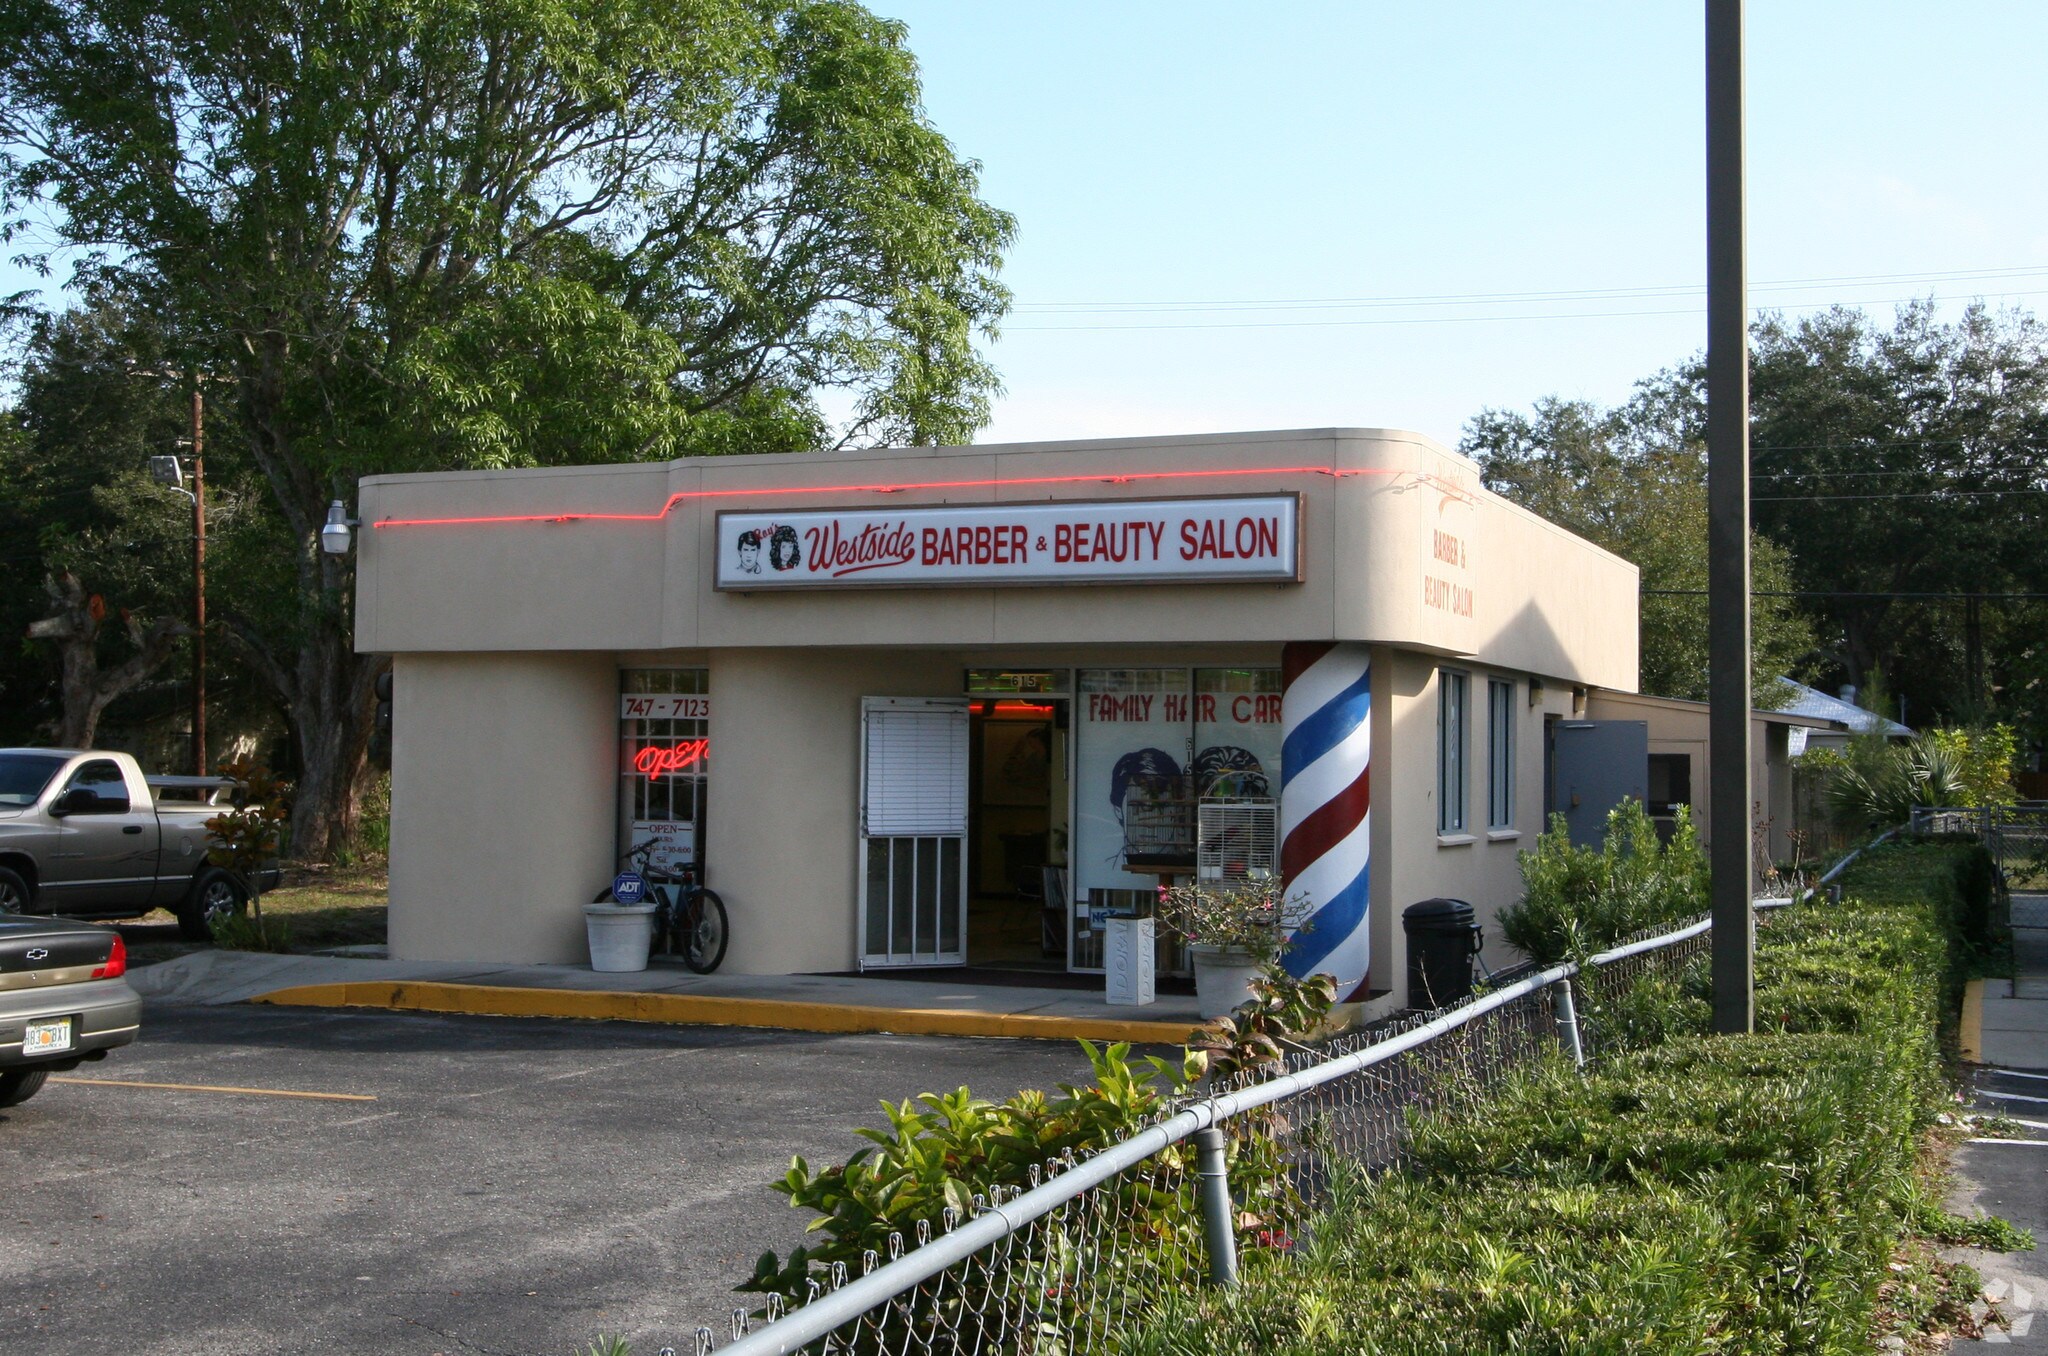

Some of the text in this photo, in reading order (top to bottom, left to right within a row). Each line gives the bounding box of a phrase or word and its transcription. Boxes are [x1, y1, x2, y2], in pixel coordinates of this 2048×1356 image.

[804, 517, 1278, 578] Westside BARBER & BEAUTY SALON
[1433, 528, 1467, 569] BARBER &
[1424, 574, 1474, 619] BEAUTY SALON
[1011, 675, 1036, 687] 615
[625, 698, 655, 717] 747
[672, 698, 710, 717] 7123
[1088, 693, 1154, 722] FAMILY
[1230, 694, 1282, 724] CAR
[648, 824, 679, 834] OPEN
[617, 881, 641, 893] ADT
